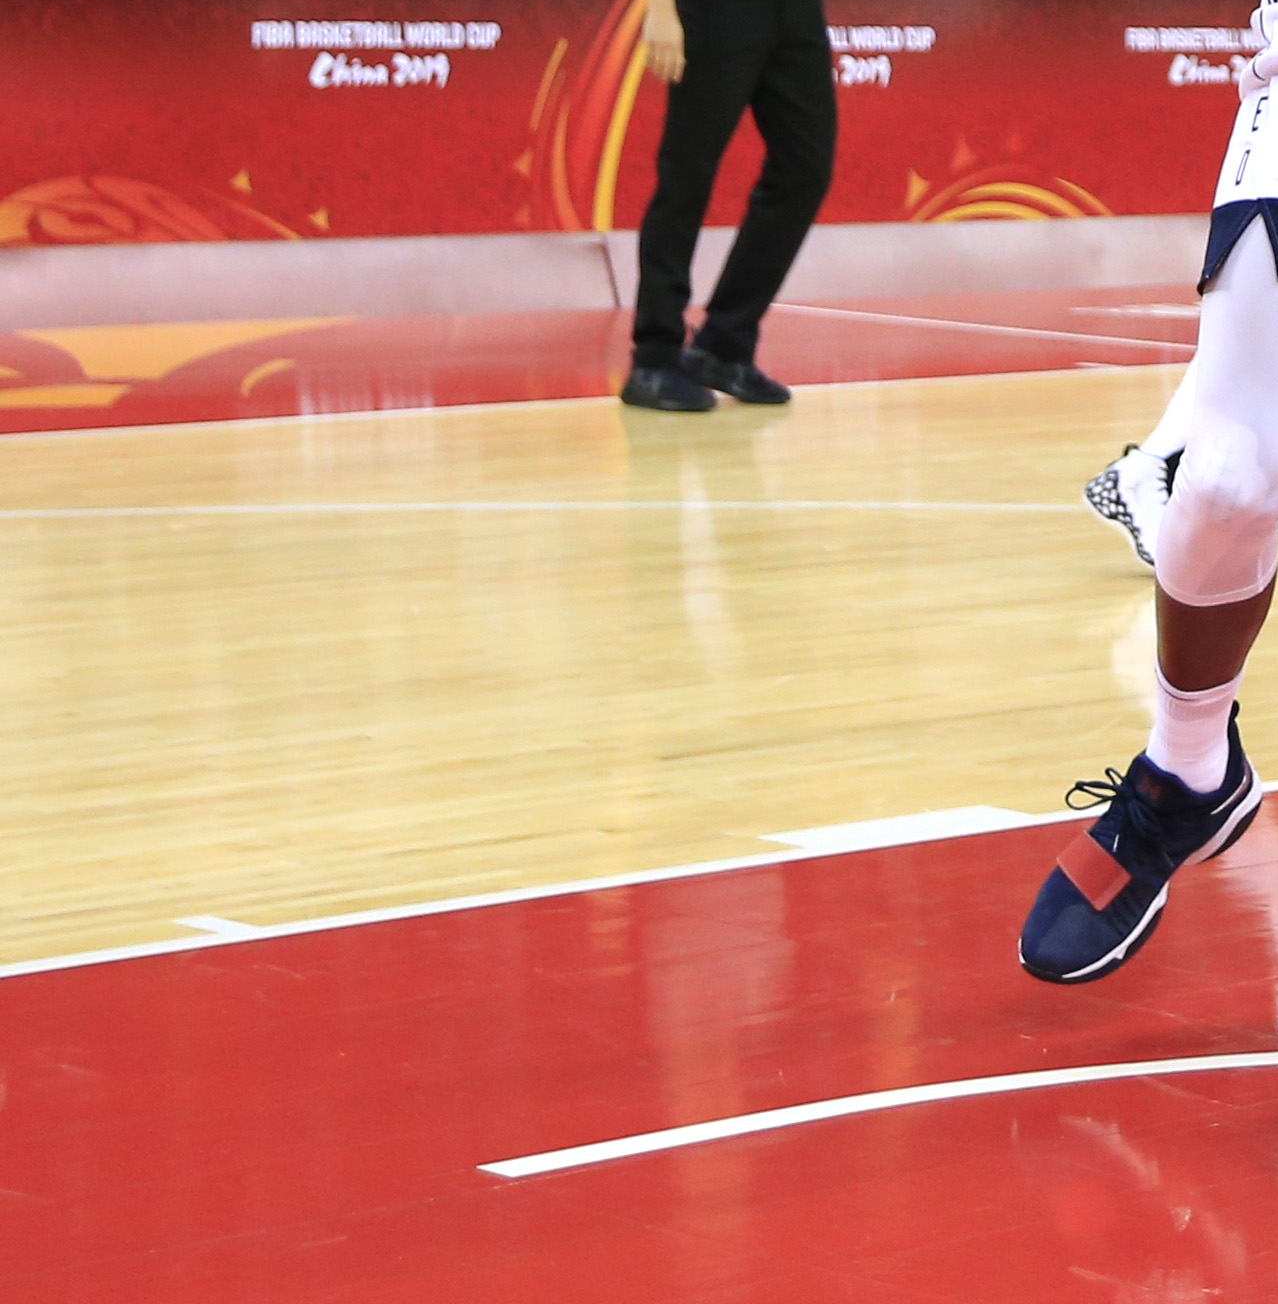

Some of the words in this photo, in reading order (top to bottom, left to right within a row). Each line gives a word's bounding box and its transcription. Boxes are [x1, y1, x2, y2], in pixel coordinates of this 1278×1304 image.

[251, 20, 295, 50] FIBA
[295, 20, 404, 49] BASKETBALL
[404, 21, 465, 49] WORLD
[466, 21, 502, 49] CUP
[851, 26, 902, 51] WORLD
[903, 26, 936, 51] CUP
[308, 50, 390, 89] China
[391, 51, 451, 89] 2019
[839, 53, 893, 88] 2019
